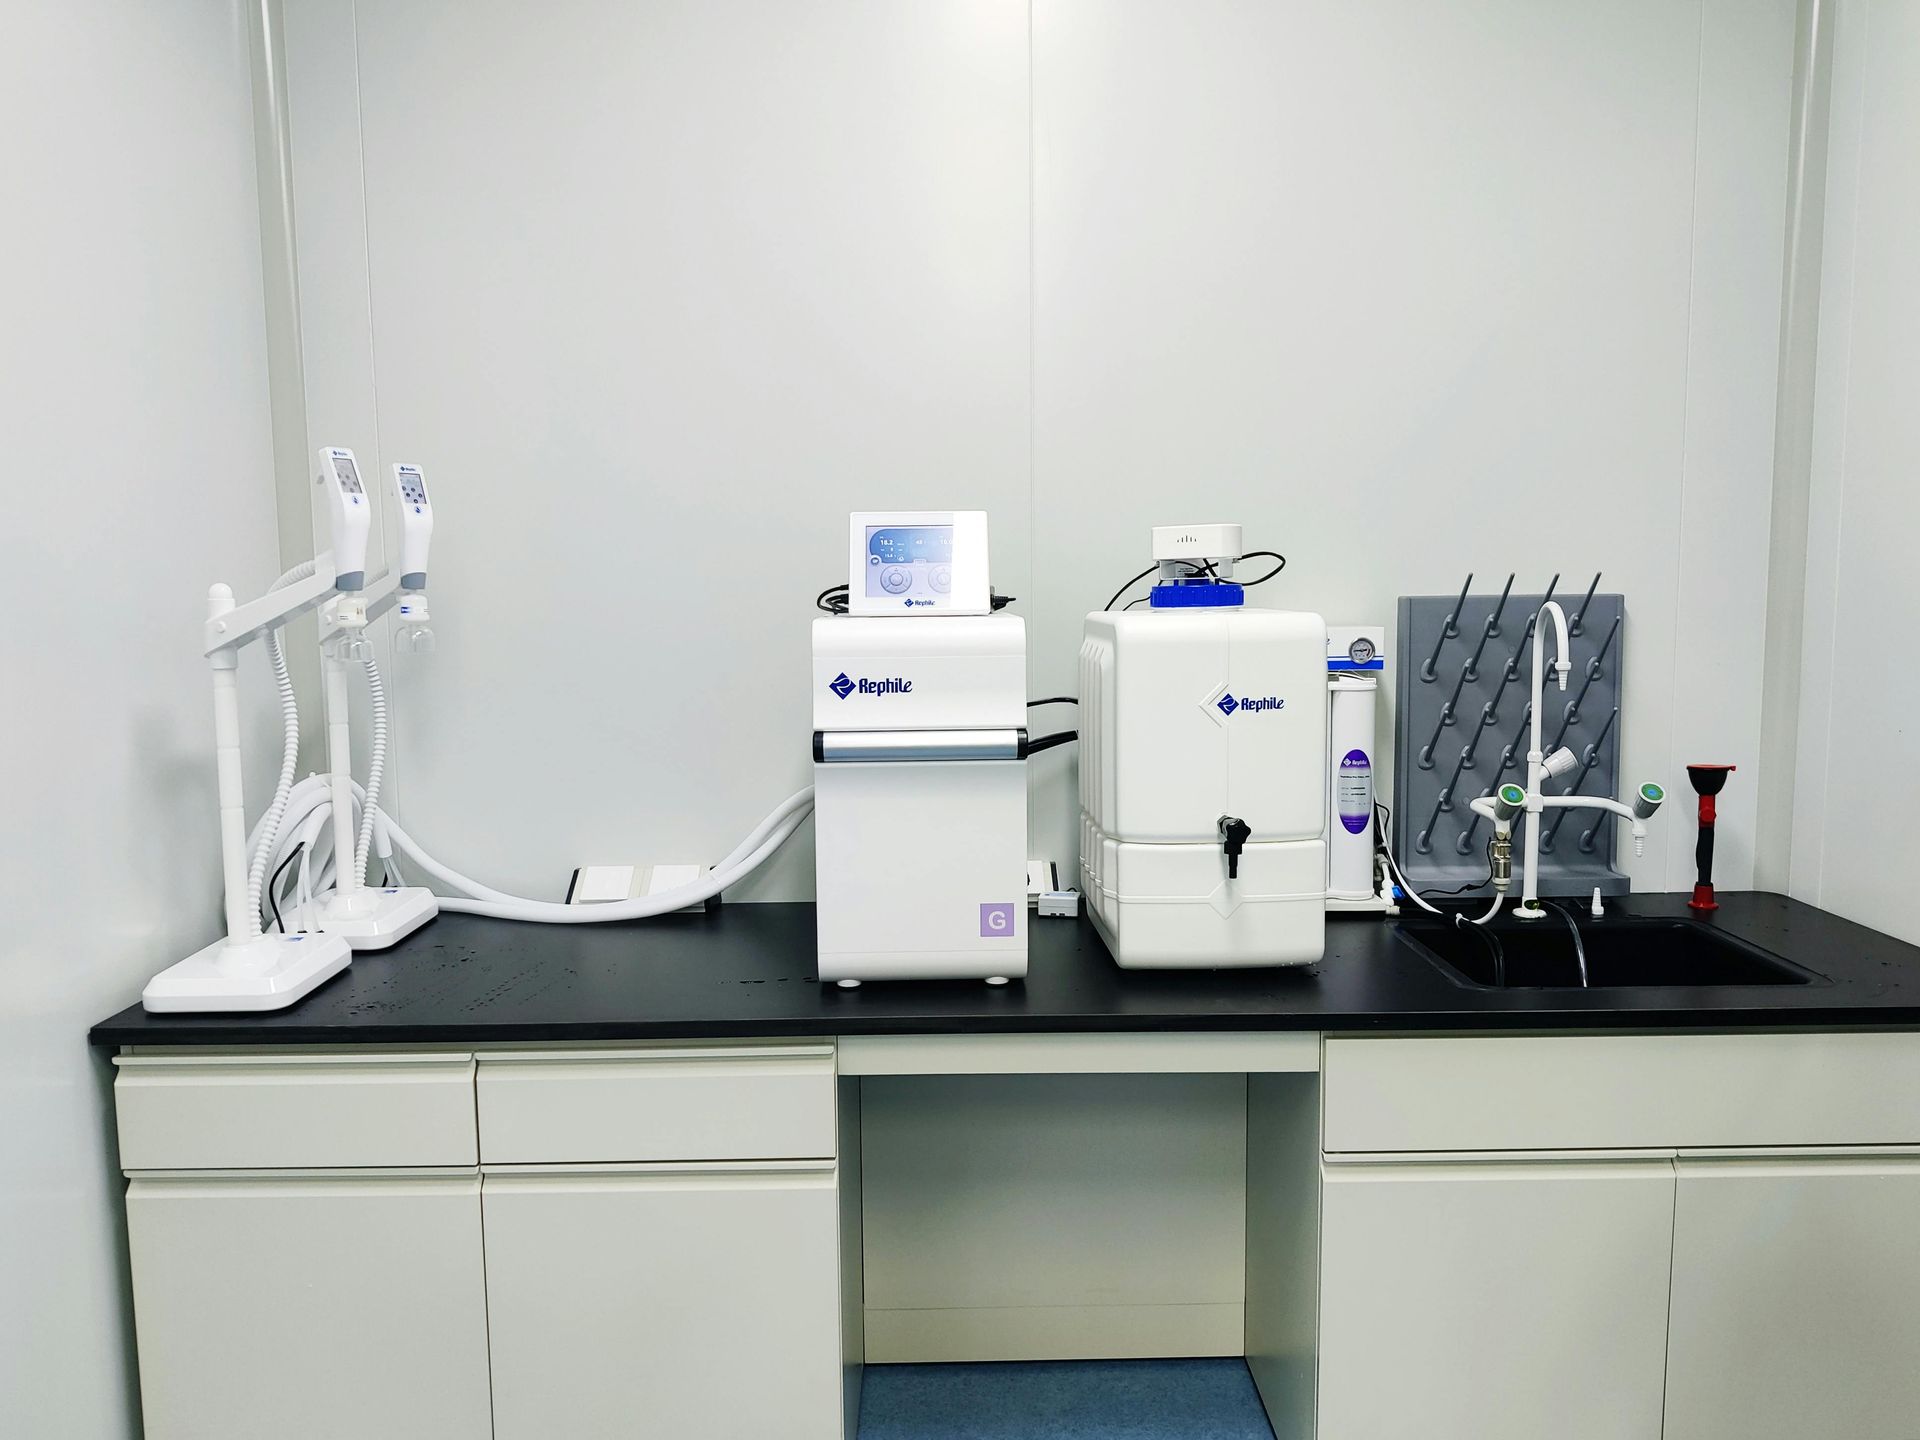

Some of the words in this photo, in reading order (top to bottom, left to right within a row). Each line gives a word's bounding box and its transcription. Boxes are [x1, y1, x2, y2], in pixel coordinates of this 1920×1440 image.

[858, 678, 912, 696] Rephile
[1241, 697, 1284, 713] Rephile
[988, 911, 1006, 930] G
